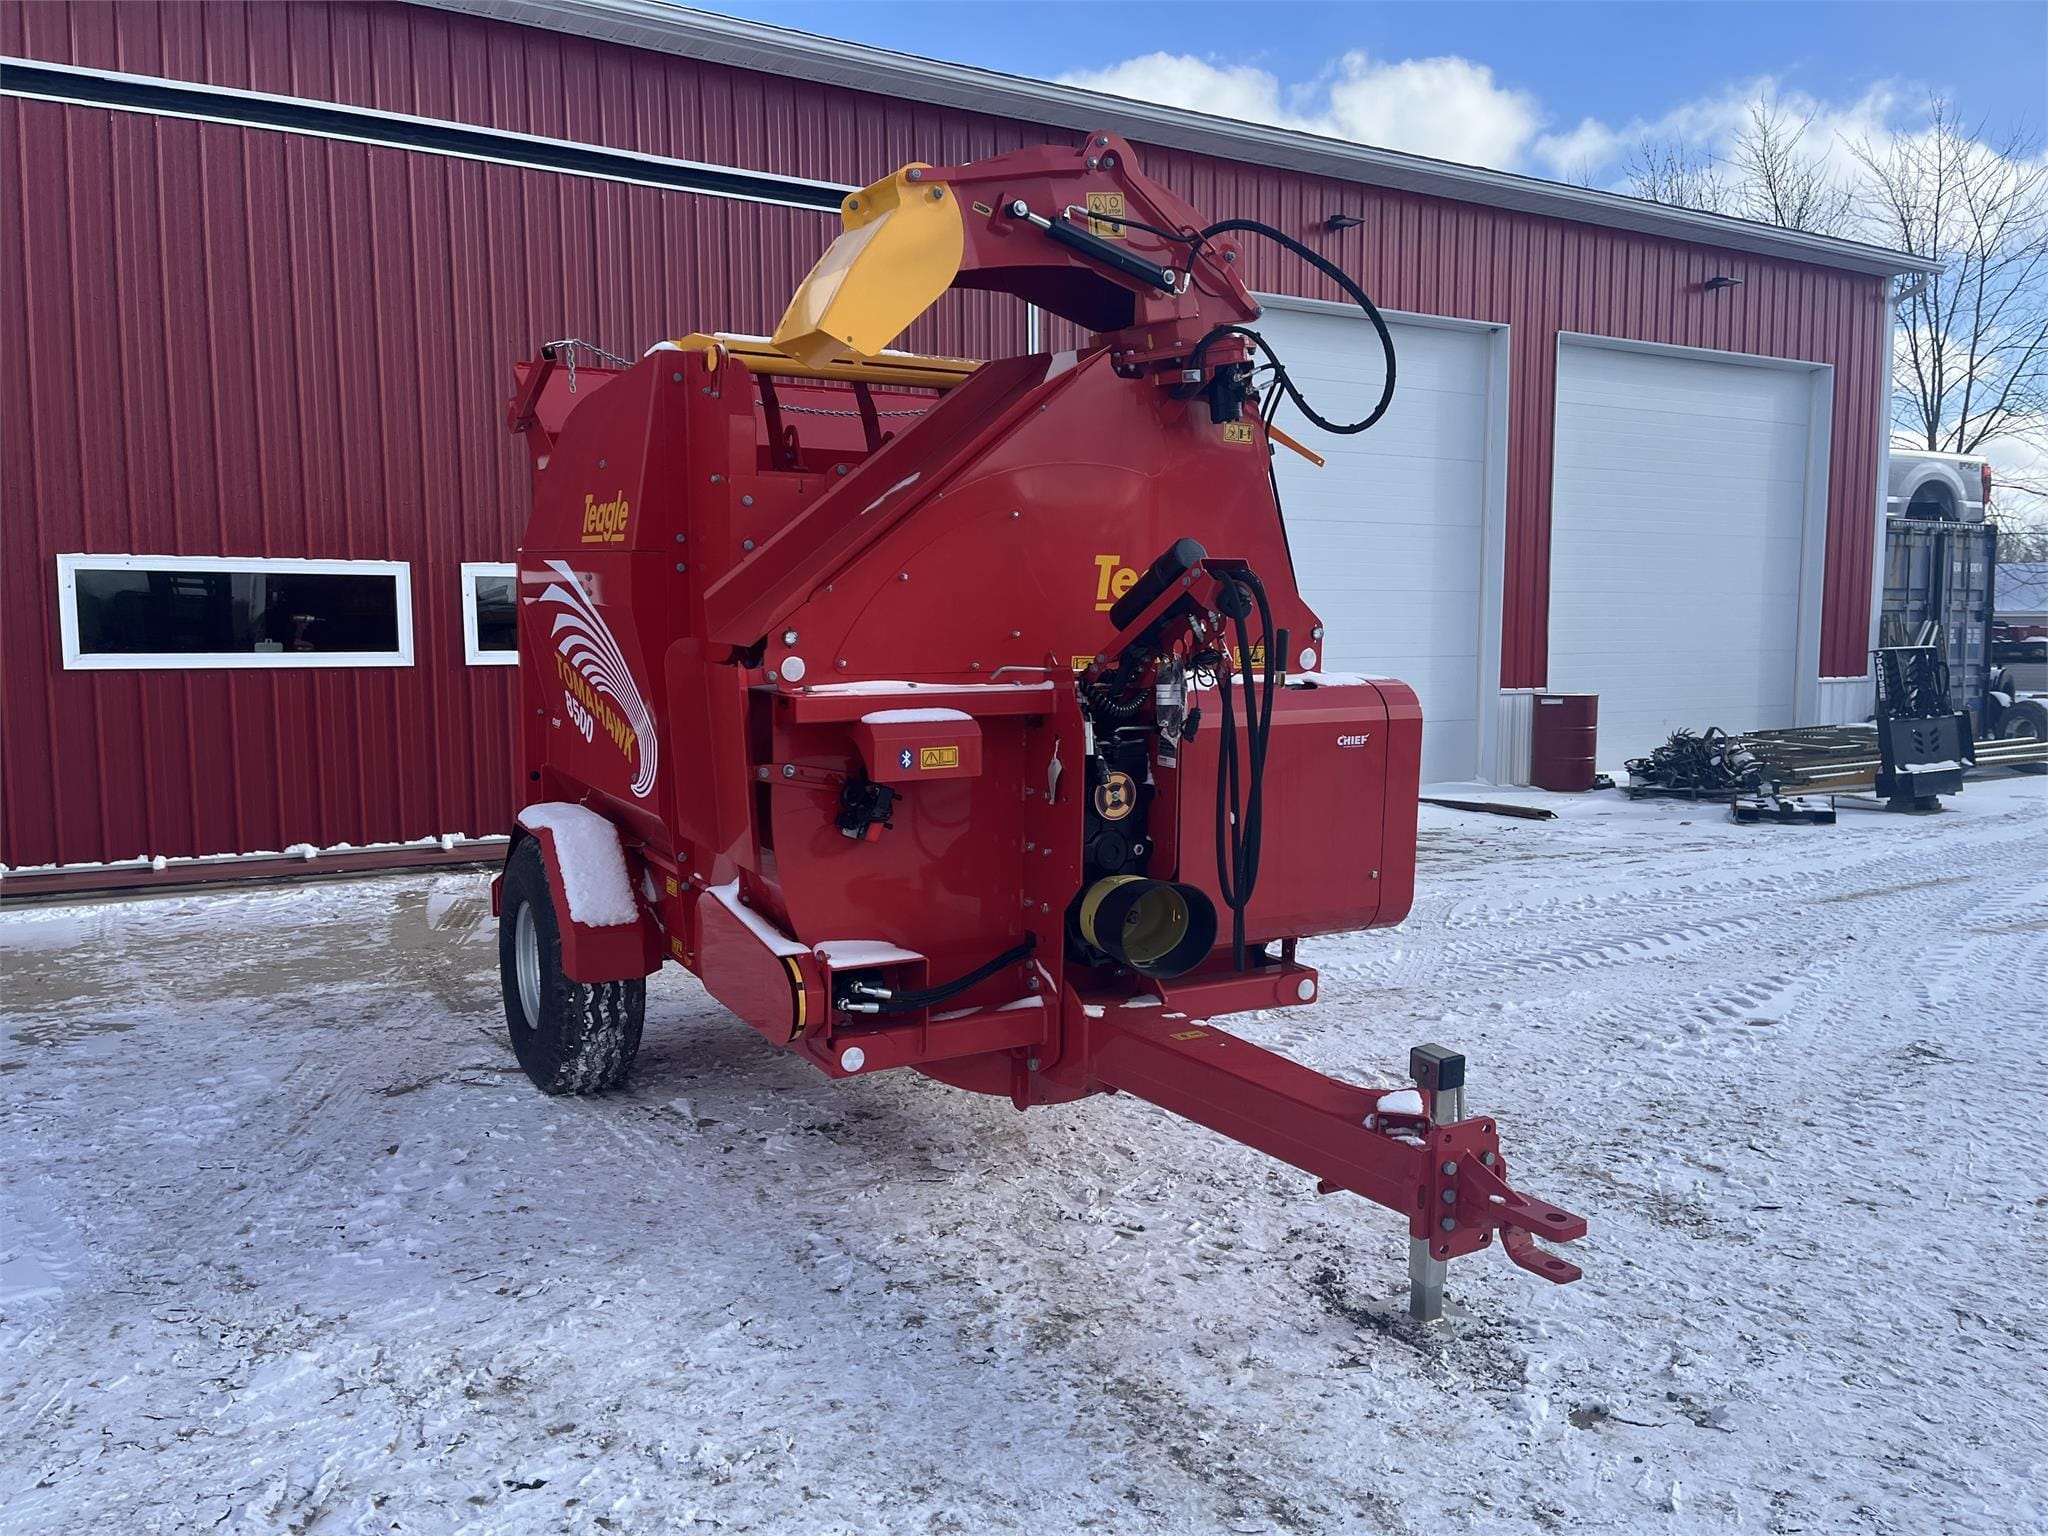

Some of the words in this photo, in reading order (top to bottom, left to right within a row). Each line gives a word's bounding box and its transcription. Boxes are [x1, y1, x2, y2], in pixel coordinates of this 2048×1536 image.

[582, 490, 629, 542] Teagle
[1094, 554, 1149, 601] Te
[554, 651, 636, 764] TOMAHAWK
[564, 690, 594, 744] 8500
[1337, 733, 1370, 748] CHIEF
